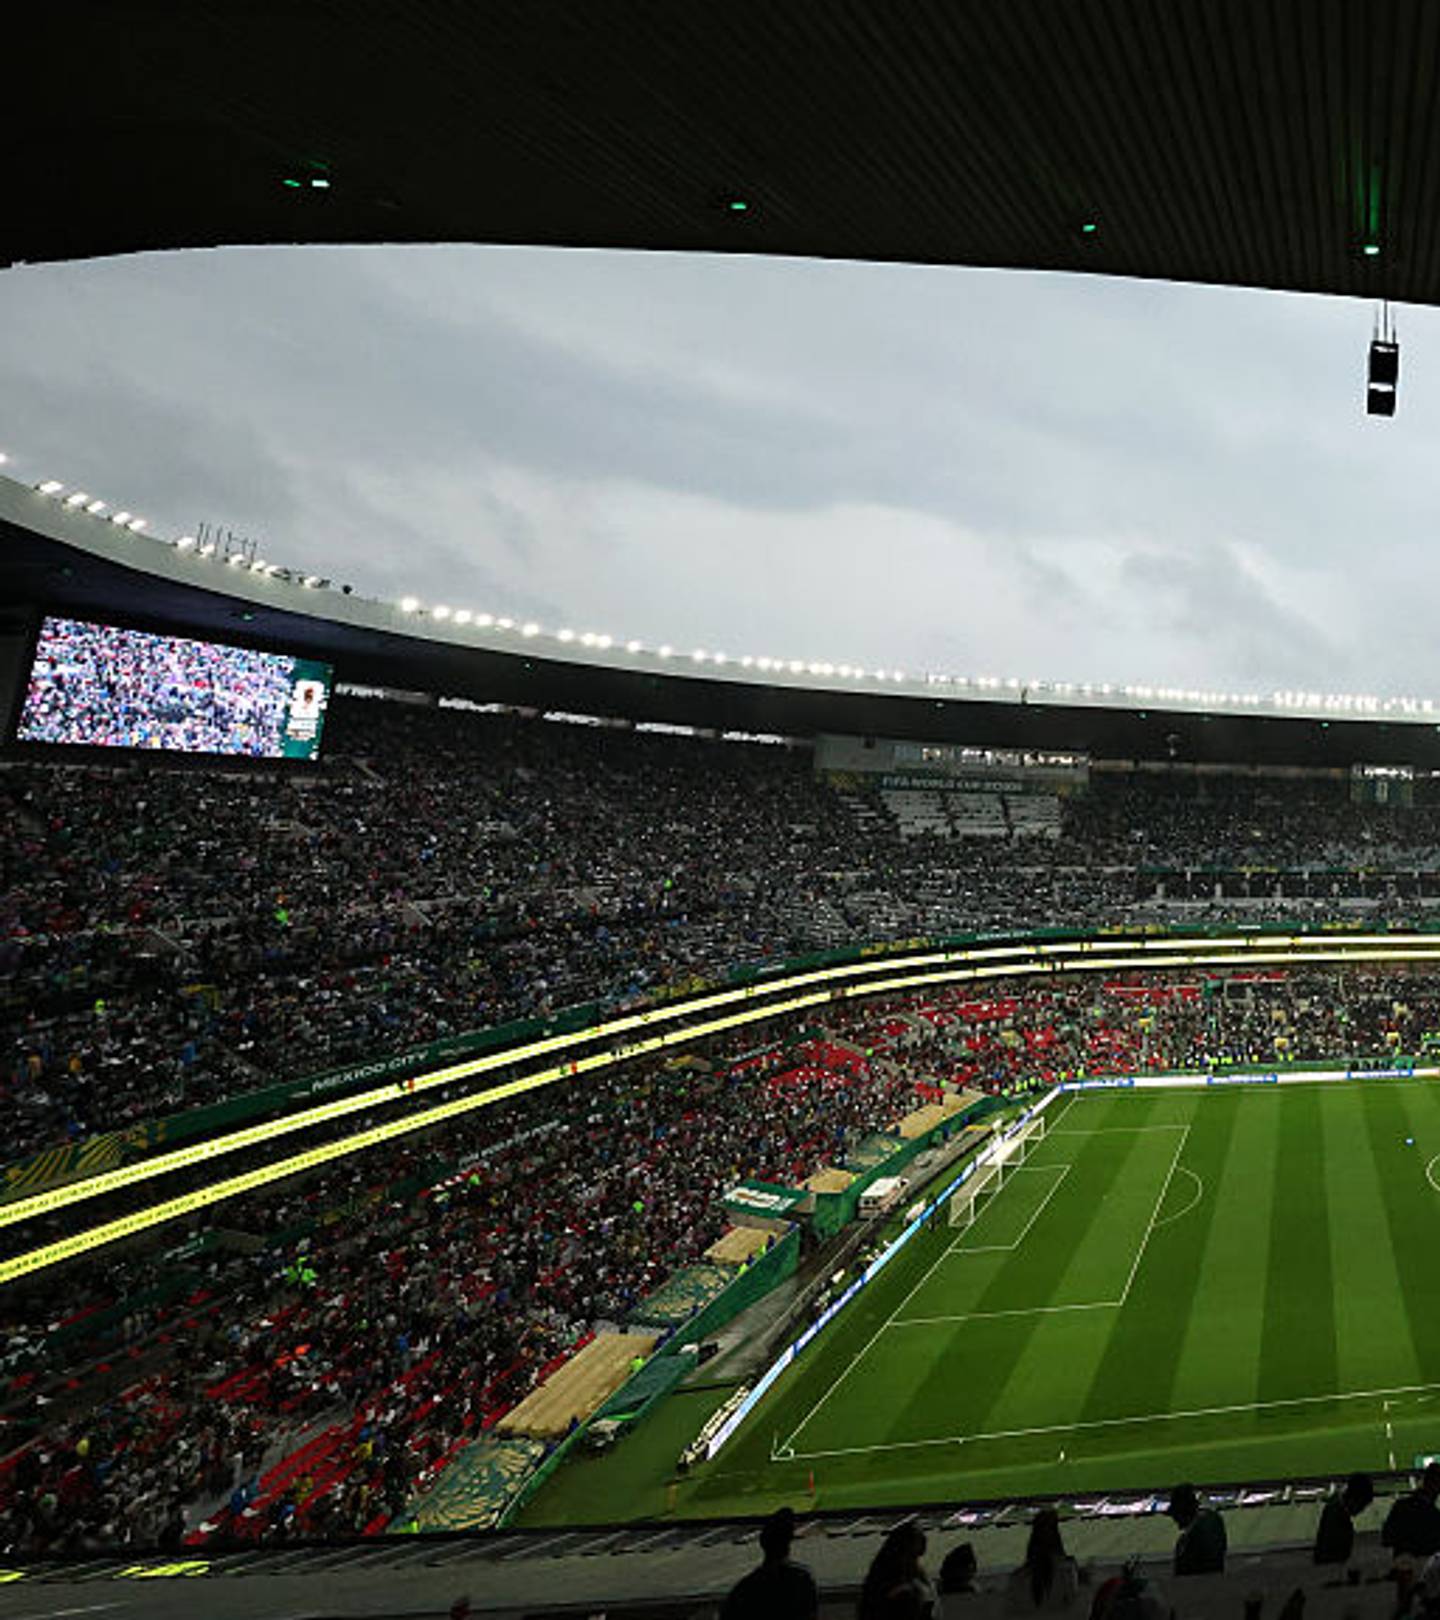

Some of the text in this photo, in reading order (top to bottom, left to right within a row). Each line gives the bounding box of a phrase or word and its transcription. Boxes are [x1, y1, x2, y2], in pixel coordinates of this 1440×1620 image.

[882, 775, 910, 787] FIFA
[911, 777, 954, 789] WORLD
[956, 779, 982, 790] CUP
[312, 1062, 387, 1092] MEXICO
[388, 1050, 429, 1070] CITY
